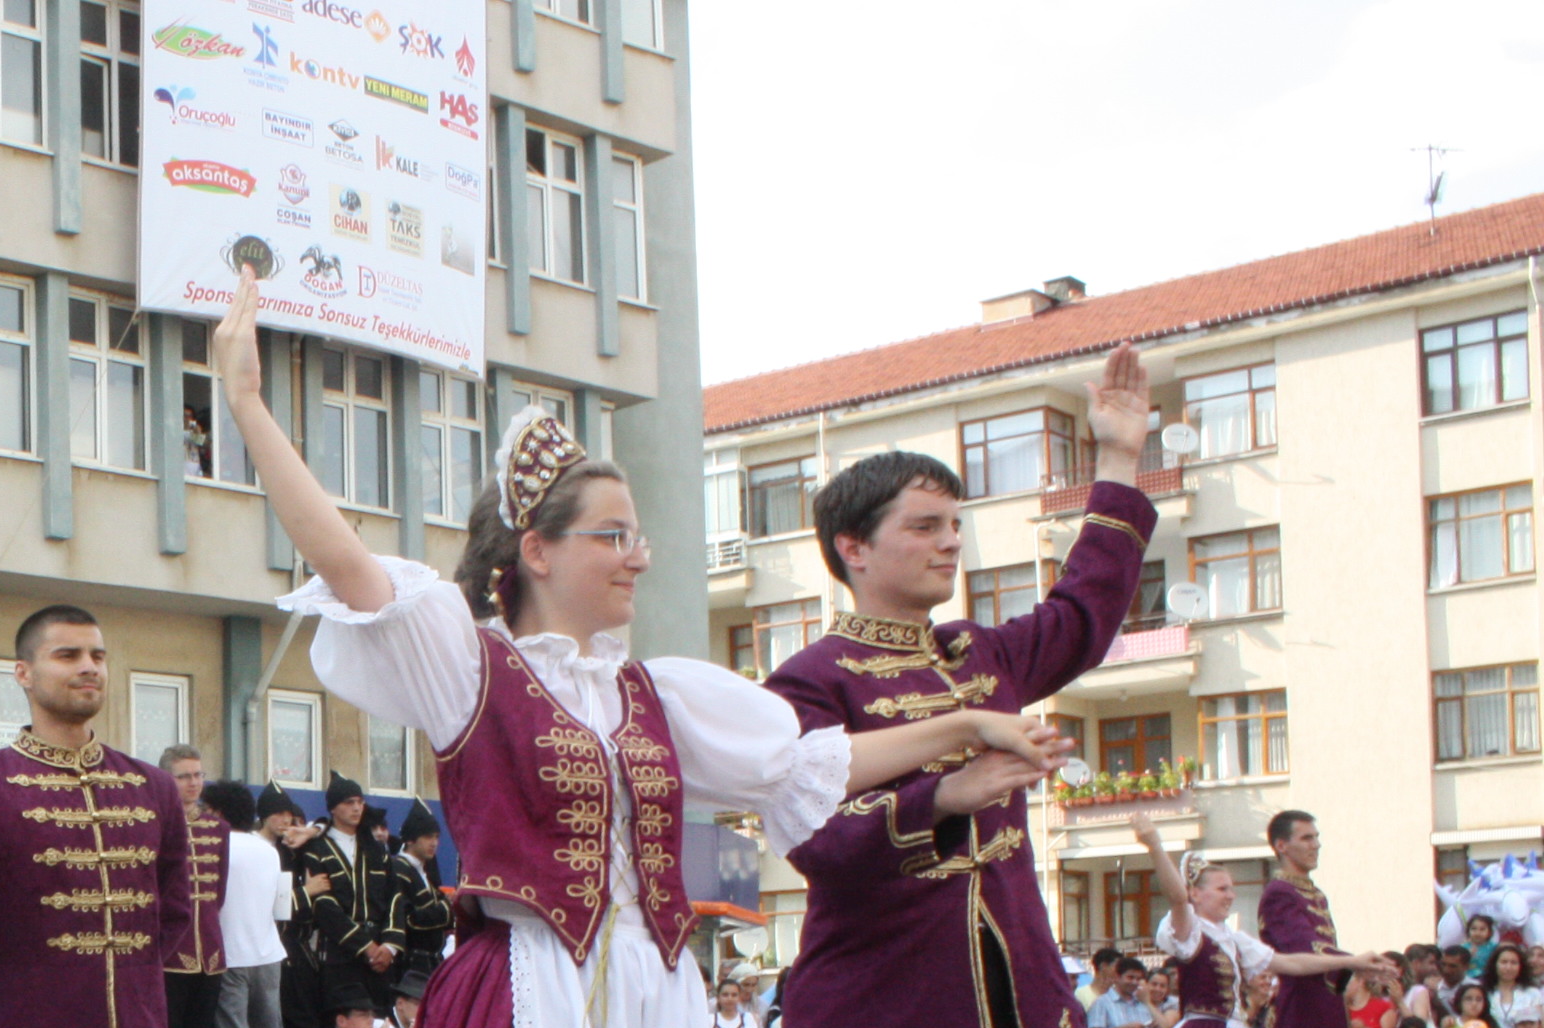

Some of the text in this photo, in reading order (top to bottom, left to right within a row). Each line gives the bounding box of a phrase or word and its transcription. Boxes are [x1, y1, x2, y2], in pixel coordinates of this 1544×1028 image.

[302, 0, 363, 29] adese
[180, 33, 246, 58] özkan
[398, 23, 445, 59] ŞOK
[391, 86, 428, 109] MERAM
[178, 104, 236, 127] Oruçoğlu
[264, 112, 312, 131] BAYINDIR
[270, 124, 307, 141] İNŞAAT
[171, 164, 249, 193] aksantaş
[395, 155, 419, 178] KALE
[318, 303, 367, 329] Sonsuz
[371, 314, 472, 361] Teşekkürlerimizle
